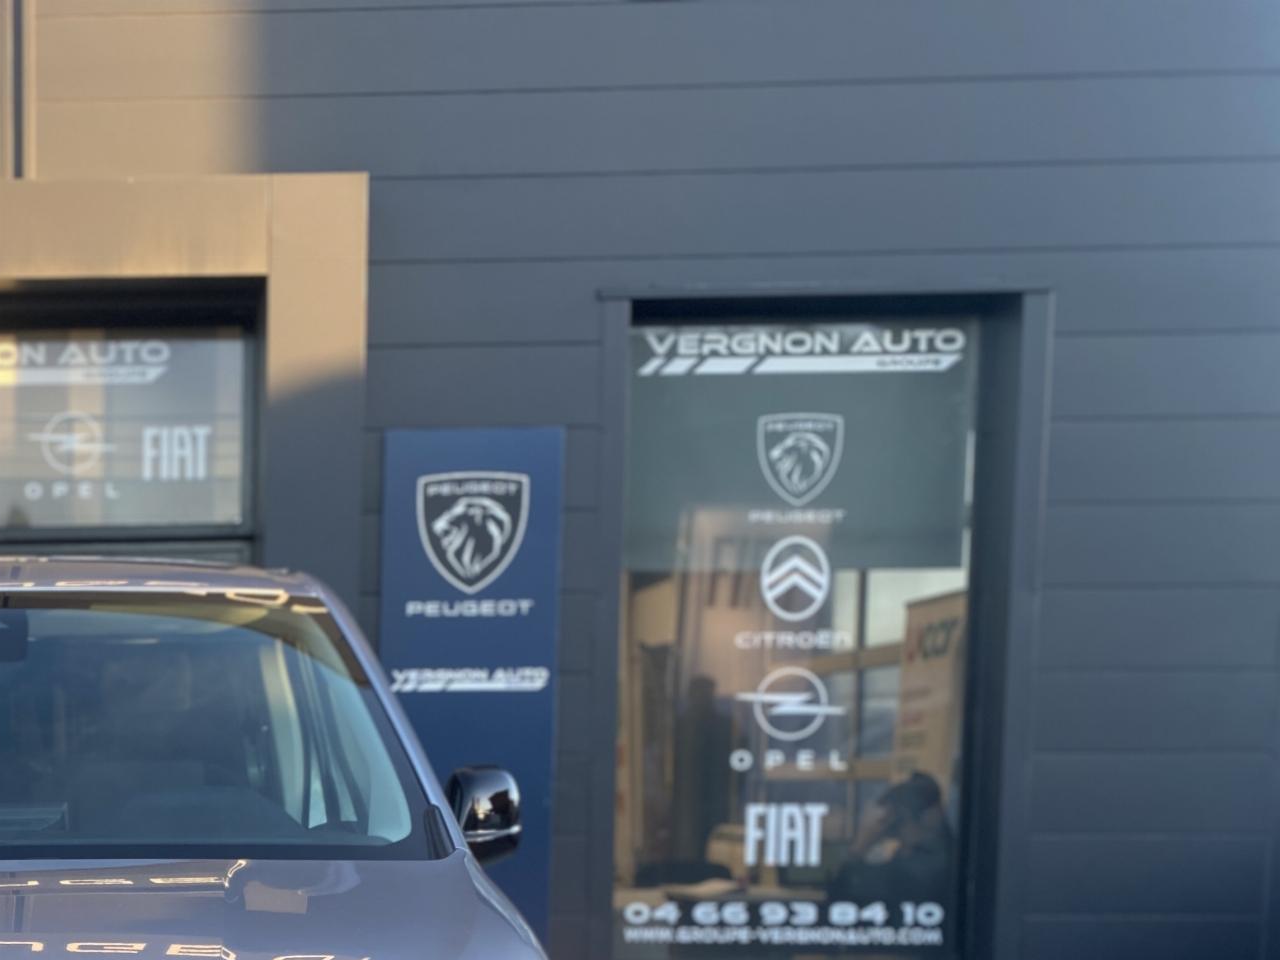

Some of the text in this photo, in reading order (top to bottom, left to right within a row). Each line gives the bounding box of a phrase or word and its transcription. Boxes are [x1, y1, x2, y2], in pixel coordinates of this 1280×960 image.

[58, 339, 171, 365] AUTO
[643, 329, 966, 355] VERGNON AUTO
[141, 425, 211, 481] FIAT
[25, 484, 120, 500] OPEL
[427, 481, 519, 496] PEUGEOT
[748, 509, 846, 523] PEUGEOT
[405, 599, 534, 617] PEUGEOT
[729, 749, 849, 772] OPEL
[744, 803, 828, 868] FIAT
[624, 902, 945, 925] 04 66 93 84 10
